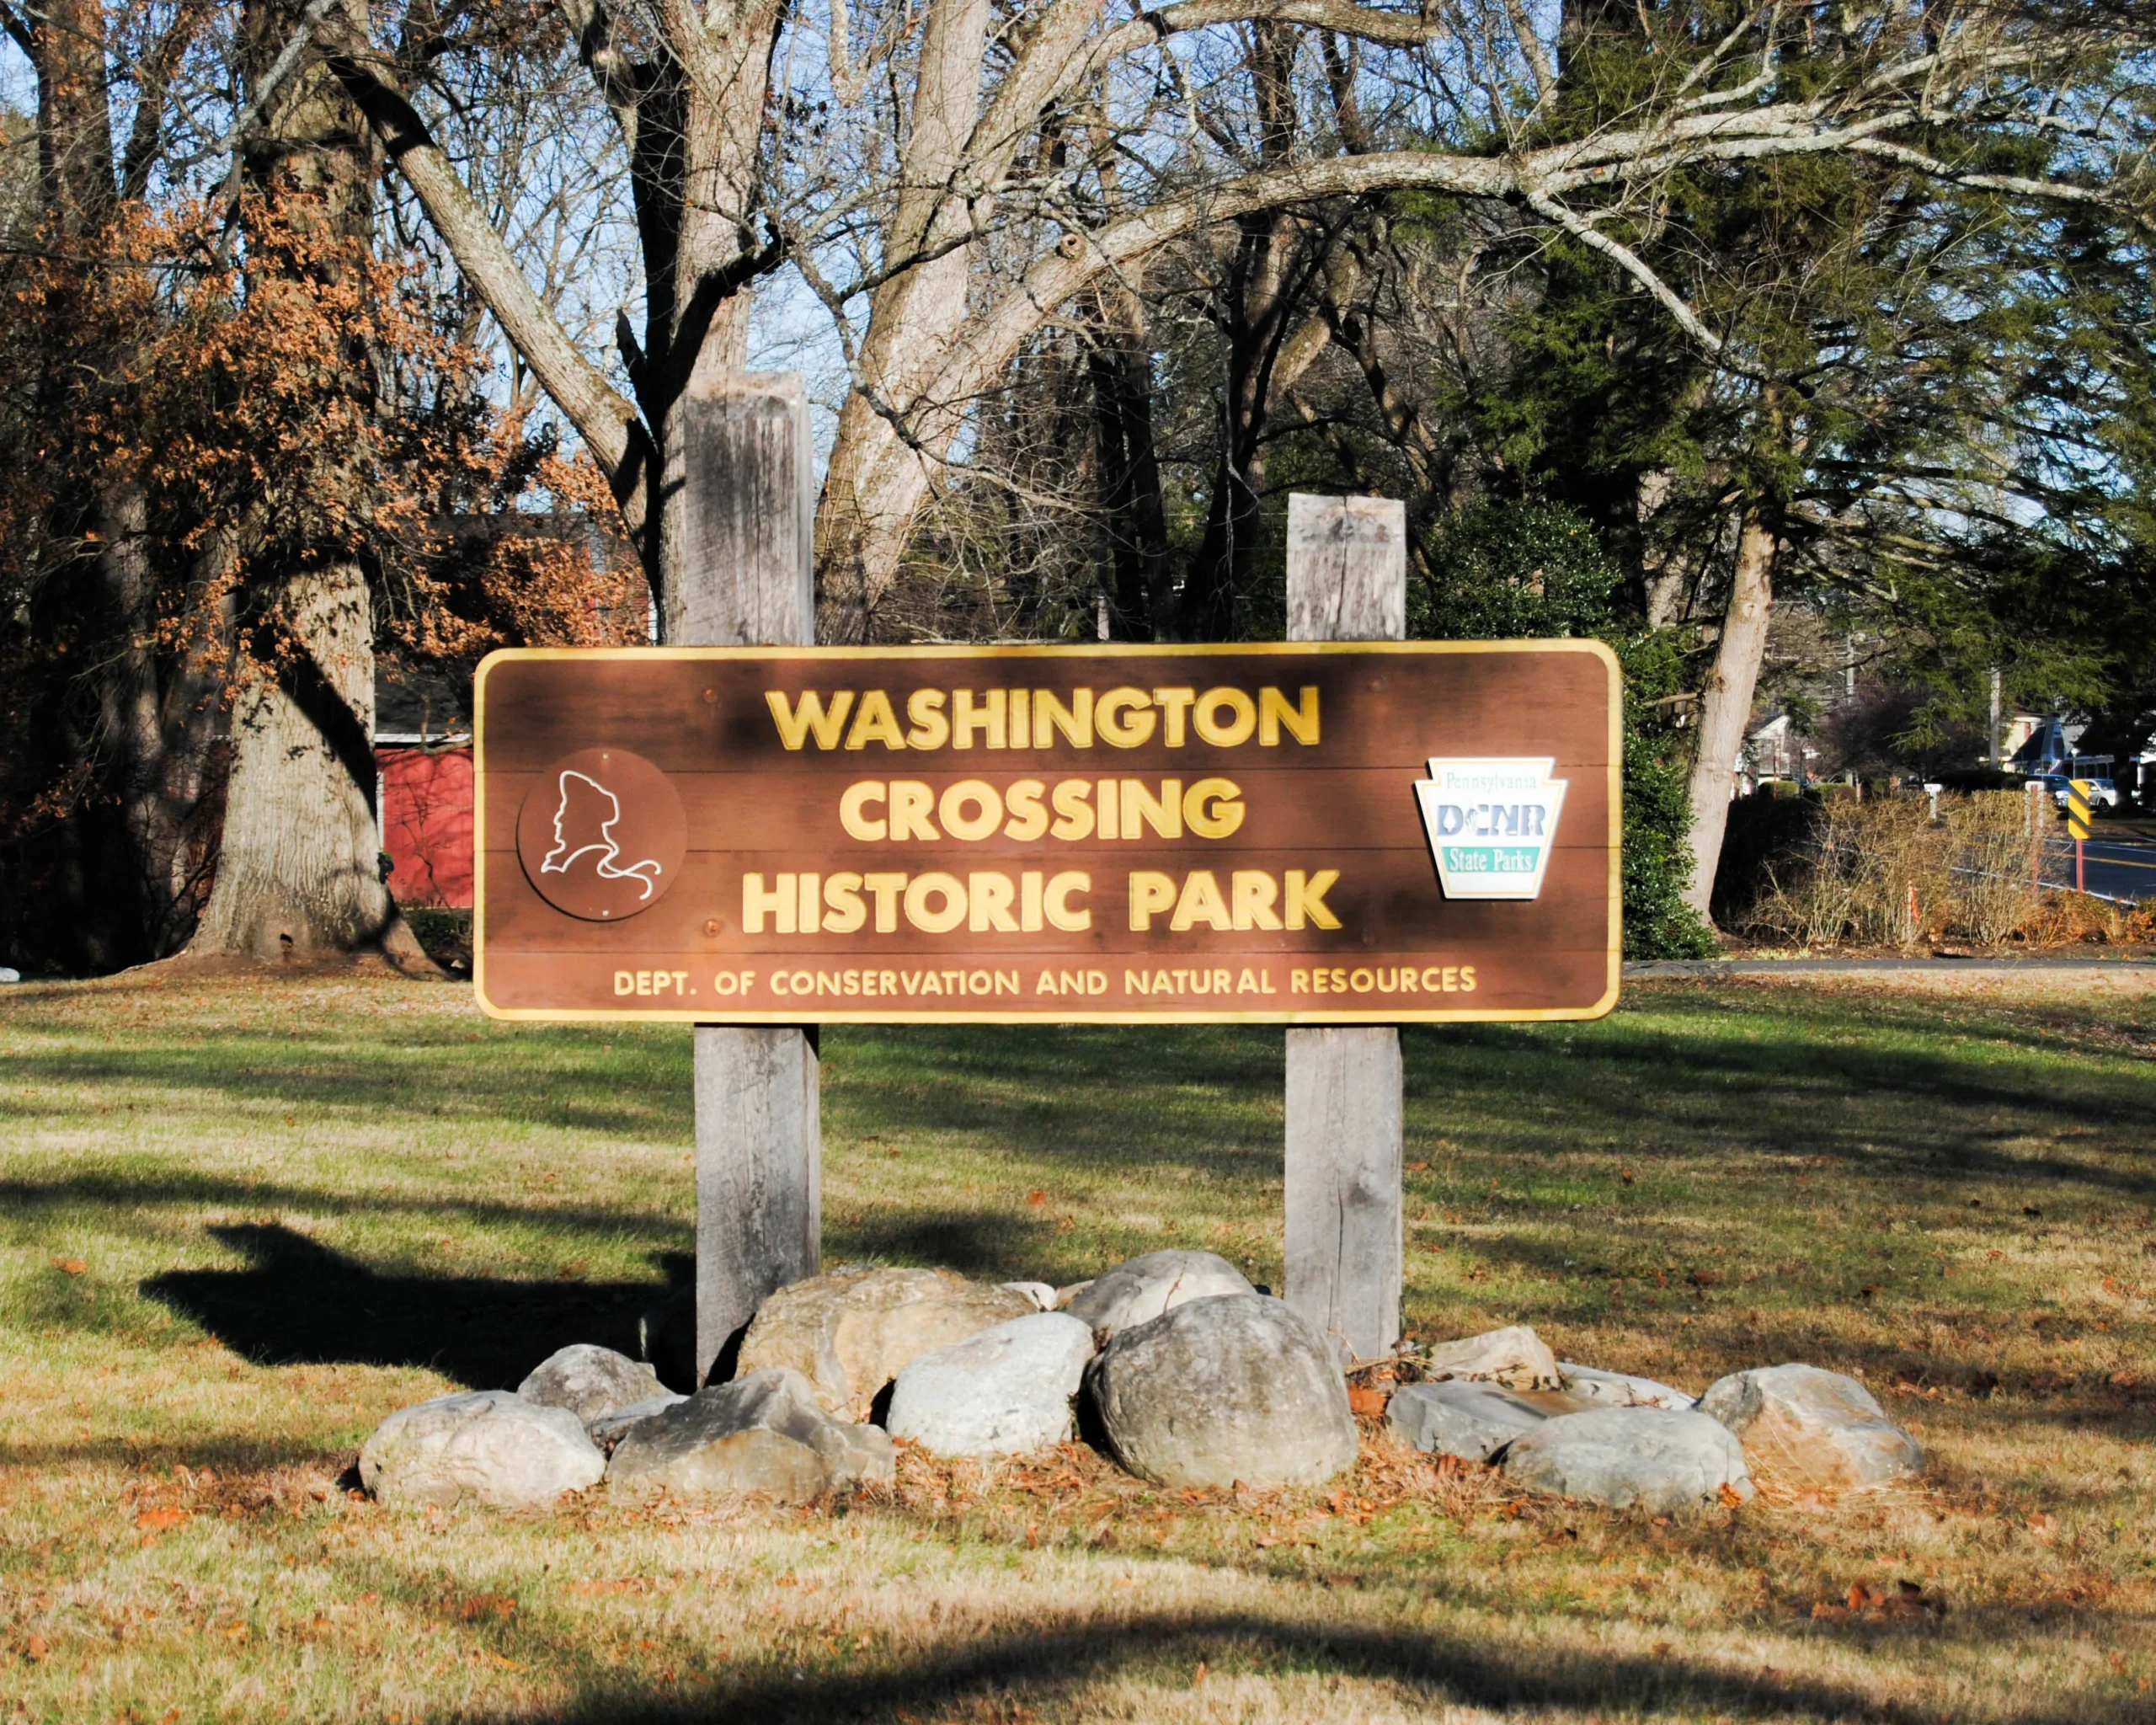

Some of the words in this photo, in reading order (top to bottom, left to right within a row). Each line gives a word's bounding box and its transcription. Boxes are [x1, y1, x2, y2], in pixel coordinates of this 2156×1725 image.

[764, 686, 1321, 751] WASHINGTON
[1446, 772, 1538, 793] Pennsylvania
[839, 778, 1246, 841] CROSSING
[1437, 804, 1546, 836] DCNR
[1449, 847, 1487, 871] State
[1492, 848, 1533, 871] Parks
[742, 870, 1092, 934] HISTORIC
[1128, 869, 1341, 932] PARK
[614, 969, 698, 996] DEPT.
[714, 969, 756, 996] OF
[770, 969, 1021, 996] CONSERVATION
[1035, 969, 1107, 996] AND
[1124, 968, 1277, 996] NATURAL
[1291, 965, 1478, 994] RESOURCES
